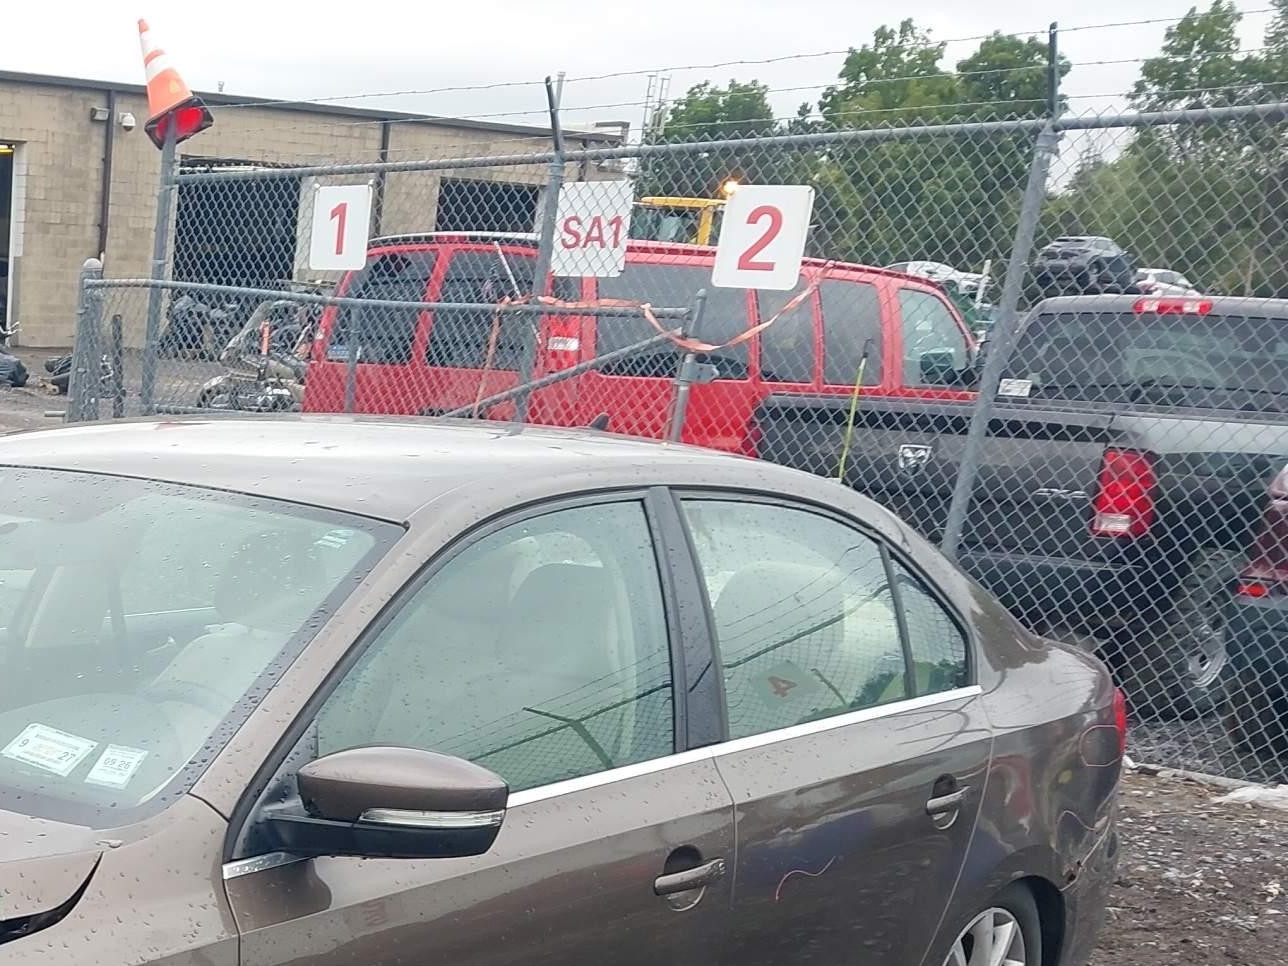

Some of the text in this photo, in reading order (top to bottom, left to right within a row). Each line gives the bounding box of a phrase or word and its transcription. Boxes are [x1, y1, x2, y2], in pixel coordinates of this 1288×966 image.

[329, 202, 348, 255] 1
[561, 215, 622, 250] SA1
[736, 205, 784, 272] 2
